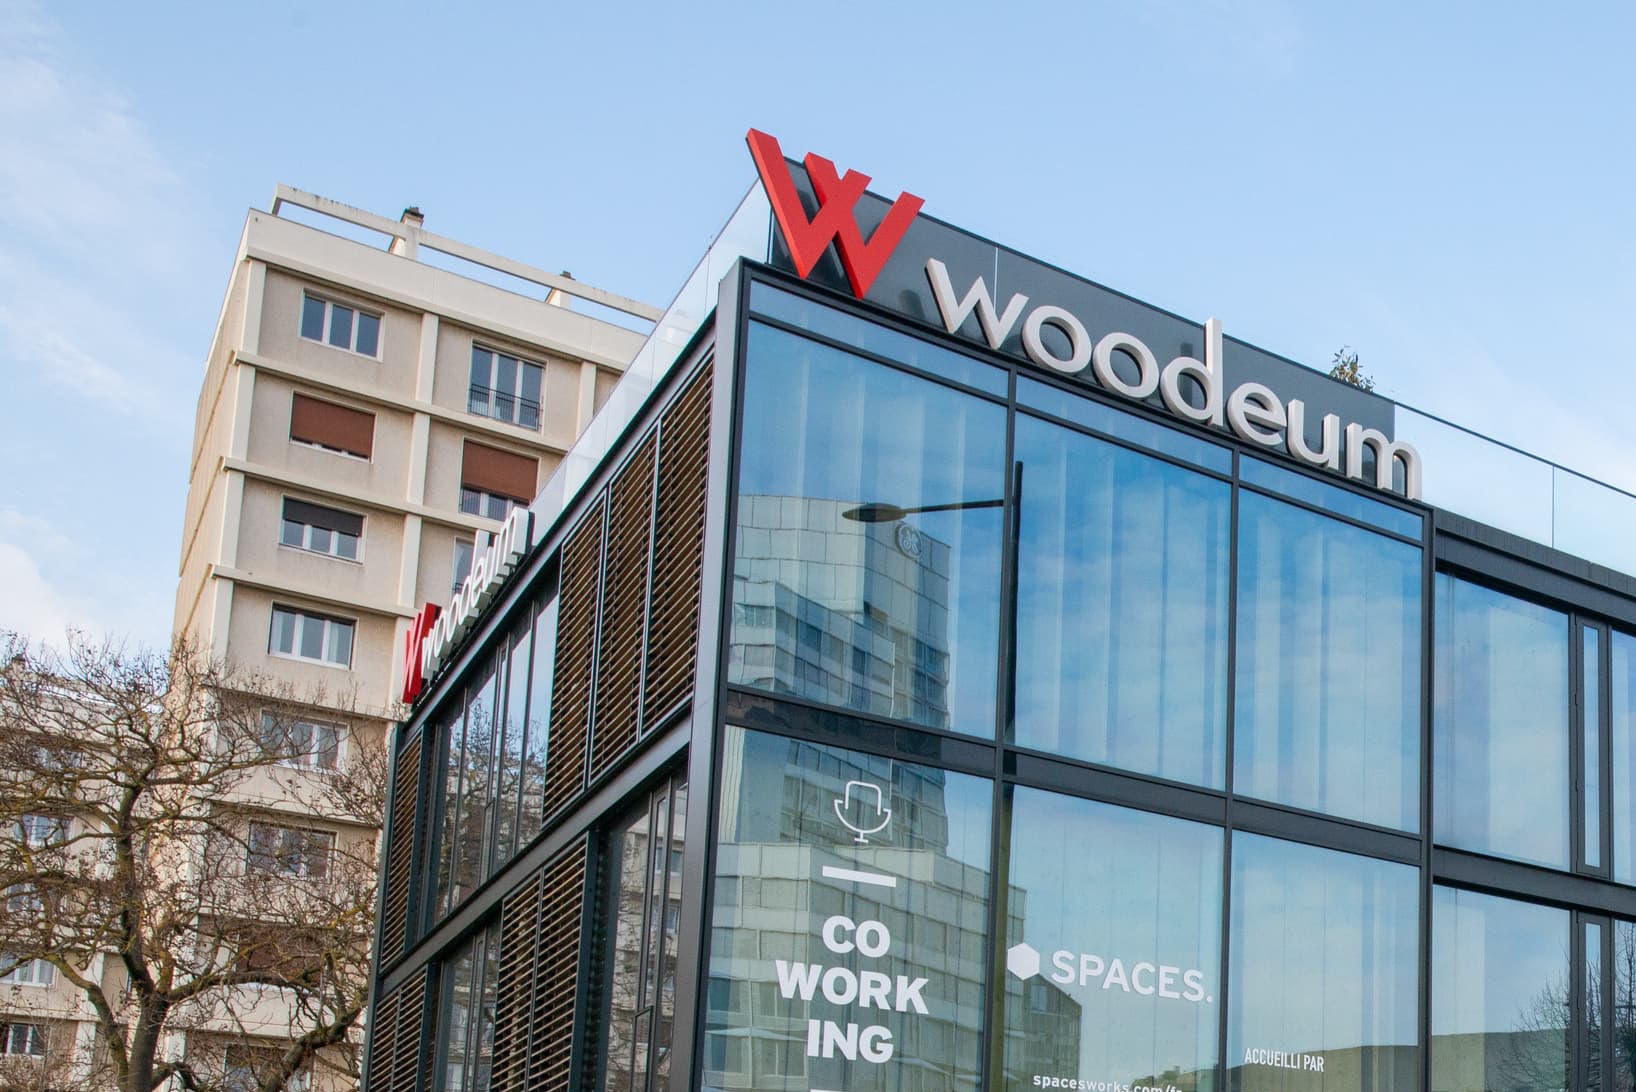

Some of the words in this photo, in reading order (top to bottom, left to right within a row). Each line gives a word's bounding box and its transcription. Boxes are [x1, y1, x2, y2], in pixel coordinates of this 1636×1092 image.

[925, 257, 1422, 500] woodeum
[822, 915, 891, 958] CO
[775, 959, 930, 1015] WORK
[1050, 949, 1214, 1004] SPACES.
[807, 1018, 894, 1064] ING
[1244, 1047, 1300, 1070] ACCUEILLI
[1303, 1054, 1325, 1073] PAR
